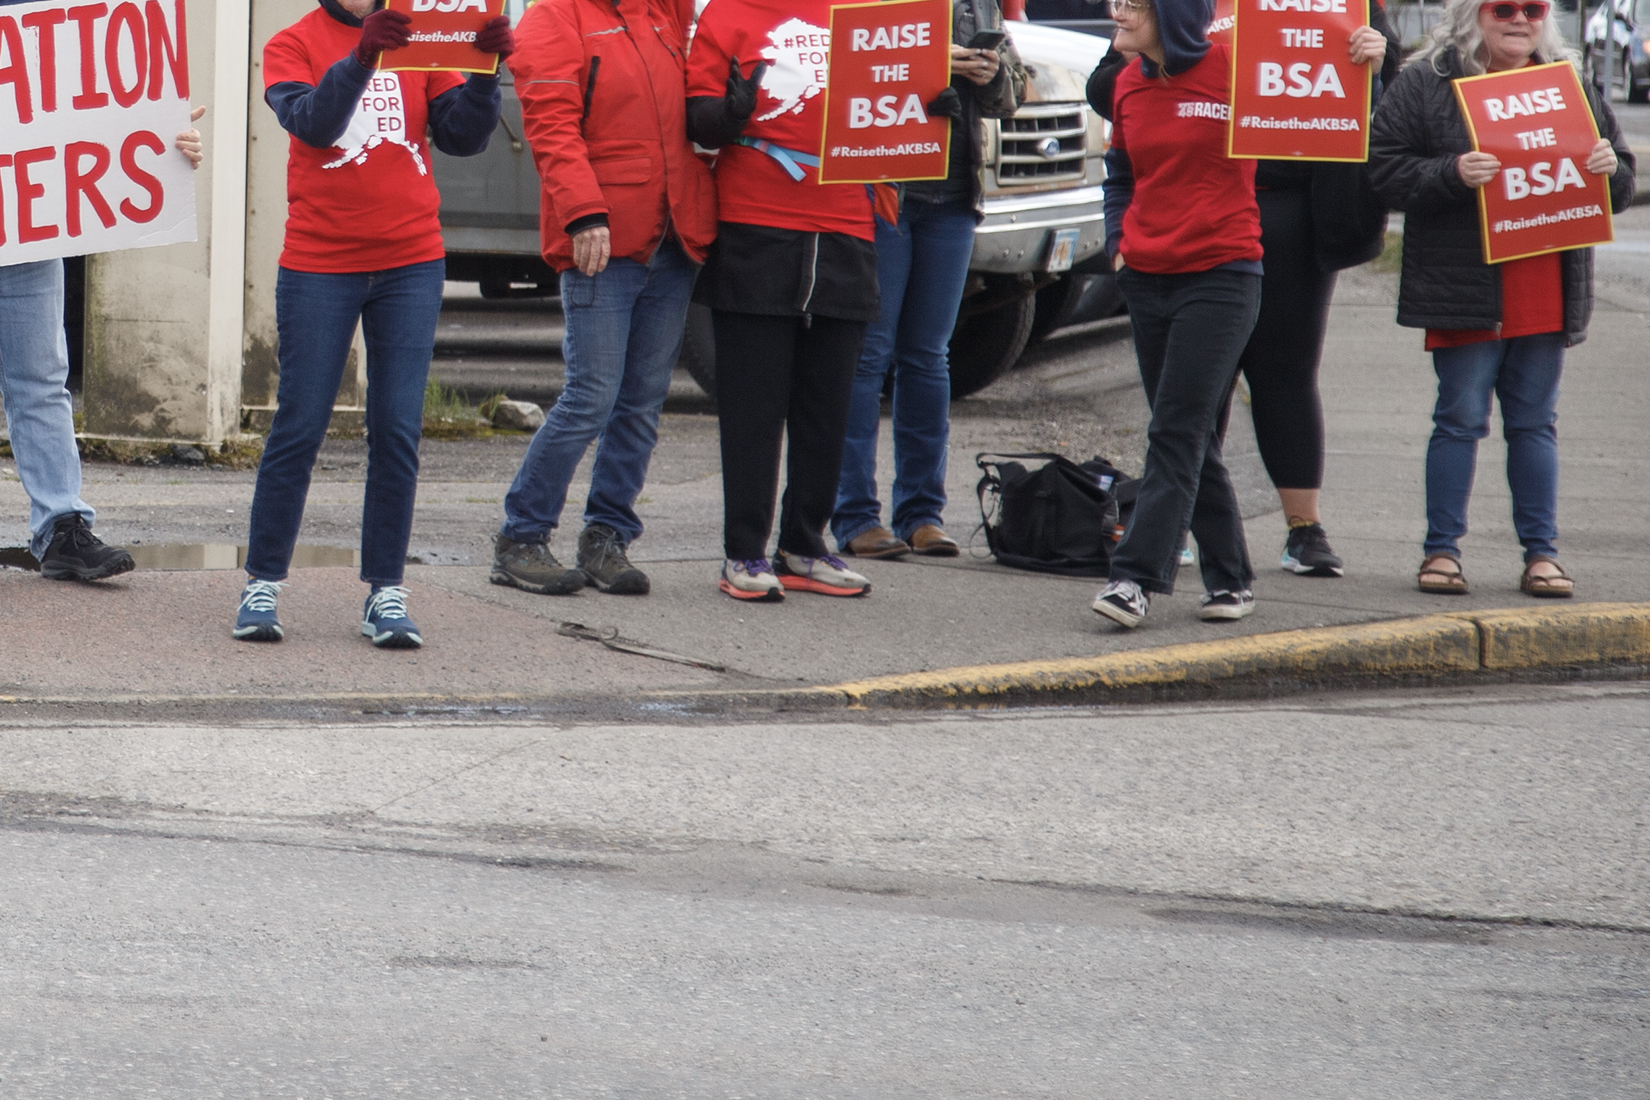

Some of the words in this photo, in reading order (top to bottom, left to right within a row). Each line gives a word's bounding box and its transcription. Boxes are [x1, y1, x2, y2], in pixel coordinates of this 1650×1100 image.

[784, 34, 830, 48] #RED
[852, 22, 930, 52] RAISE
[1280, 28, 1324, 48] THE
[871, 63, 910, 83] THE
[1258, 62, 1346, 99] BSA
[362, 97, 400, 112] FOR
[849, 93, 928, 129] BSA
[1484, 87, 1567, 122] RAISE
[377, 116, 402, 132] ED
[1240, 116, 1360, 132] #RaisetheAKBSA
[831, 142, 941, 158] #RaisetheAKBSA
[1515, 127, 1557, 151] THE
[1503, 157, 1586, 201] BSA
[1494, 204, 1603, 234] #RaisetheAKBSA
